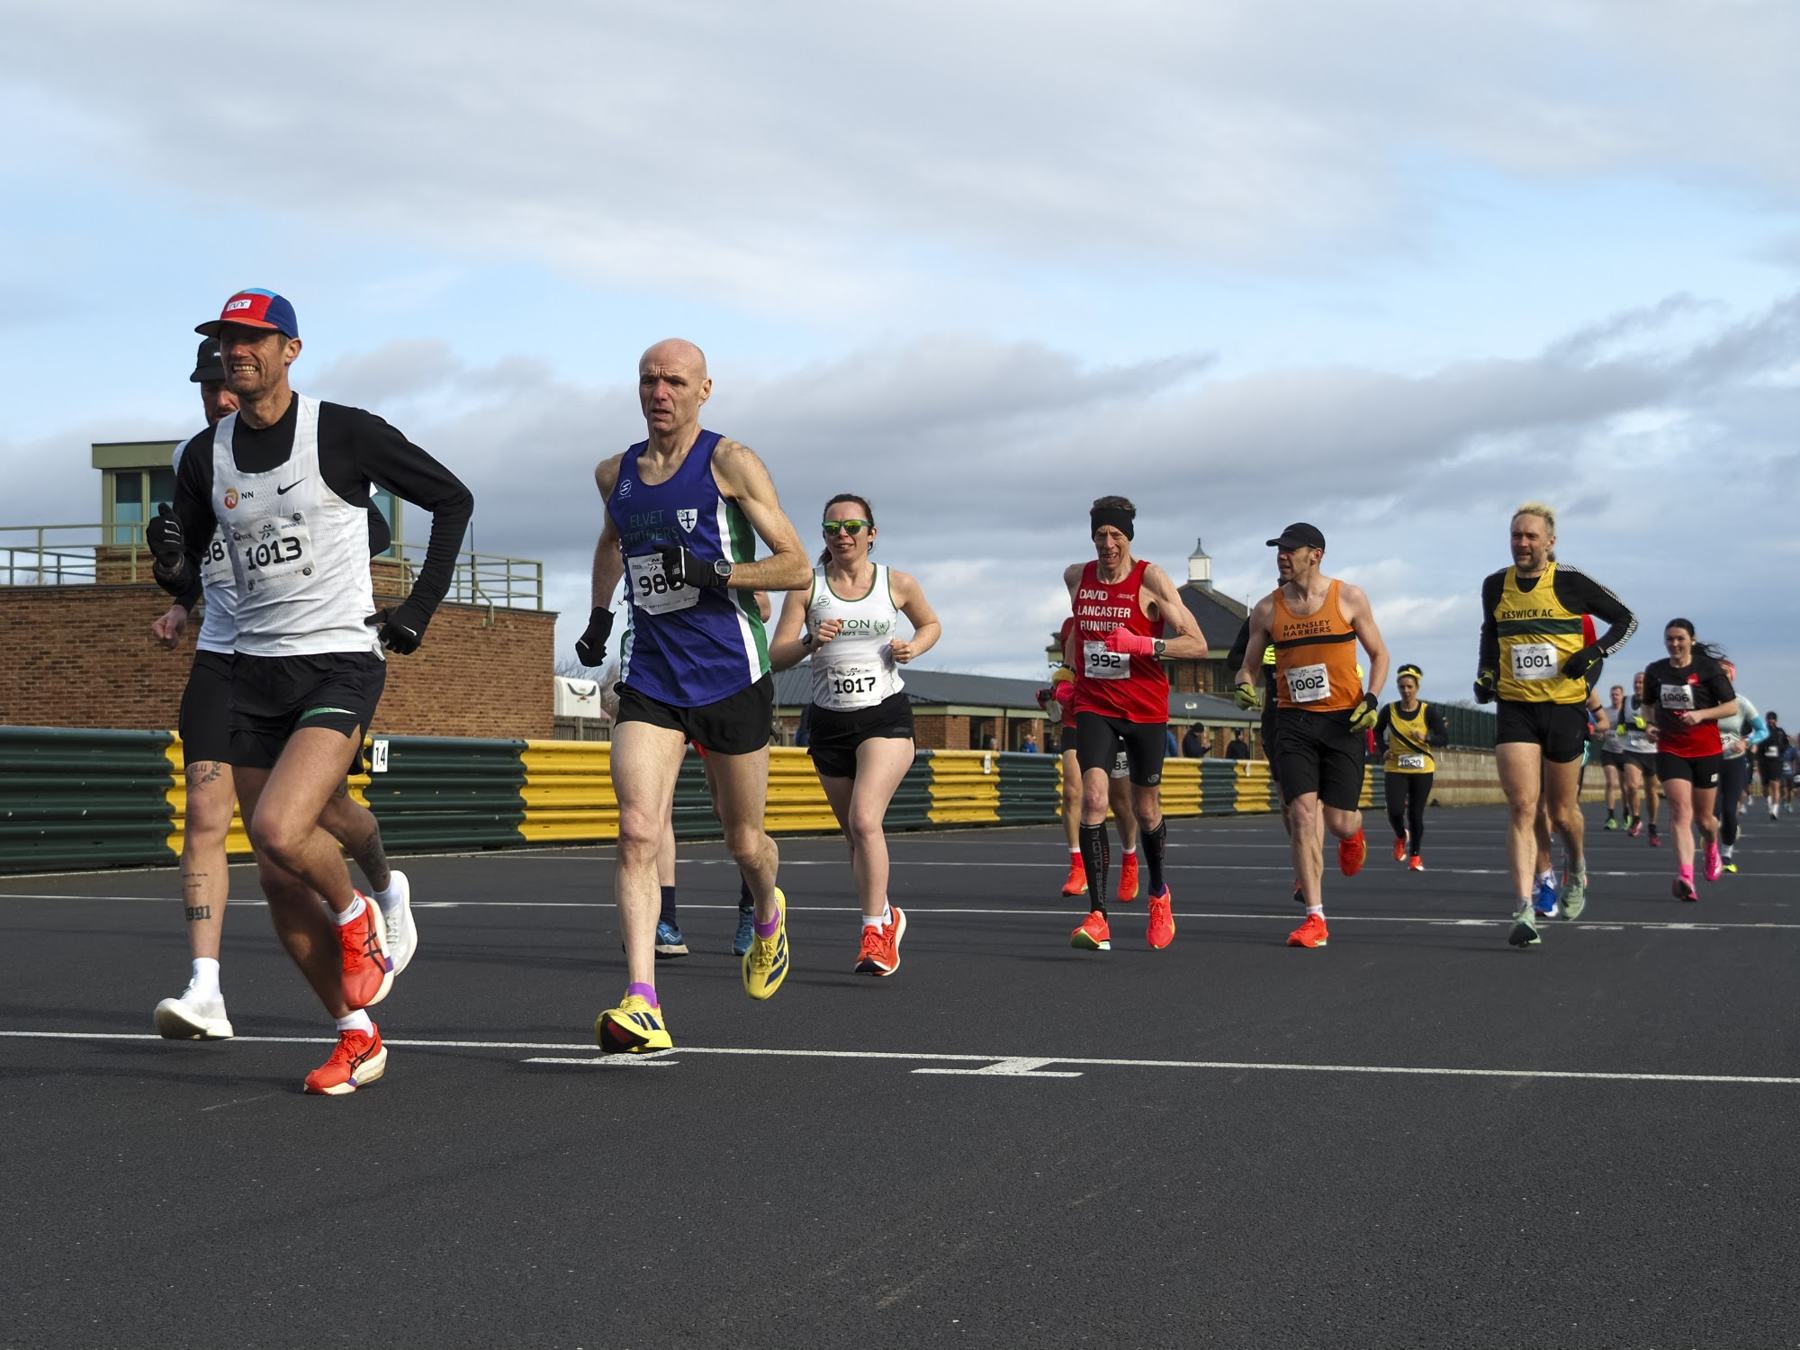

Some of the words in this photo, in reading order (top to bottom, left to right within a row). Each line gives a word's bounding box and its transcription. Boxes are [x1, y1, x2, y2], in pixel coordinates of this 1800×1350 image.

[241, 491, 254, 500] NN
[630, 509, 664, 528] ELVET
[245, 536, 303, 571] 1013
[1080, 589, 1109, 601] DAVID
[1077, 605, 1131, 618] LANCASTER
[1541, 609, 1553, 618] AC
[814, 619, 870, 629] HTON
[1283, 619, 1330, 632] BARNSLEY
[1283, 626, 1332, 637] HARRIERS
[1090, 654, 1121, 669] 992
[1516, 655, 1553, 669] 1001
[834, 677, 876, 694] 1017
[1290, 675, 1325, 692] 1002
[375, 746, 386, 766] 14
